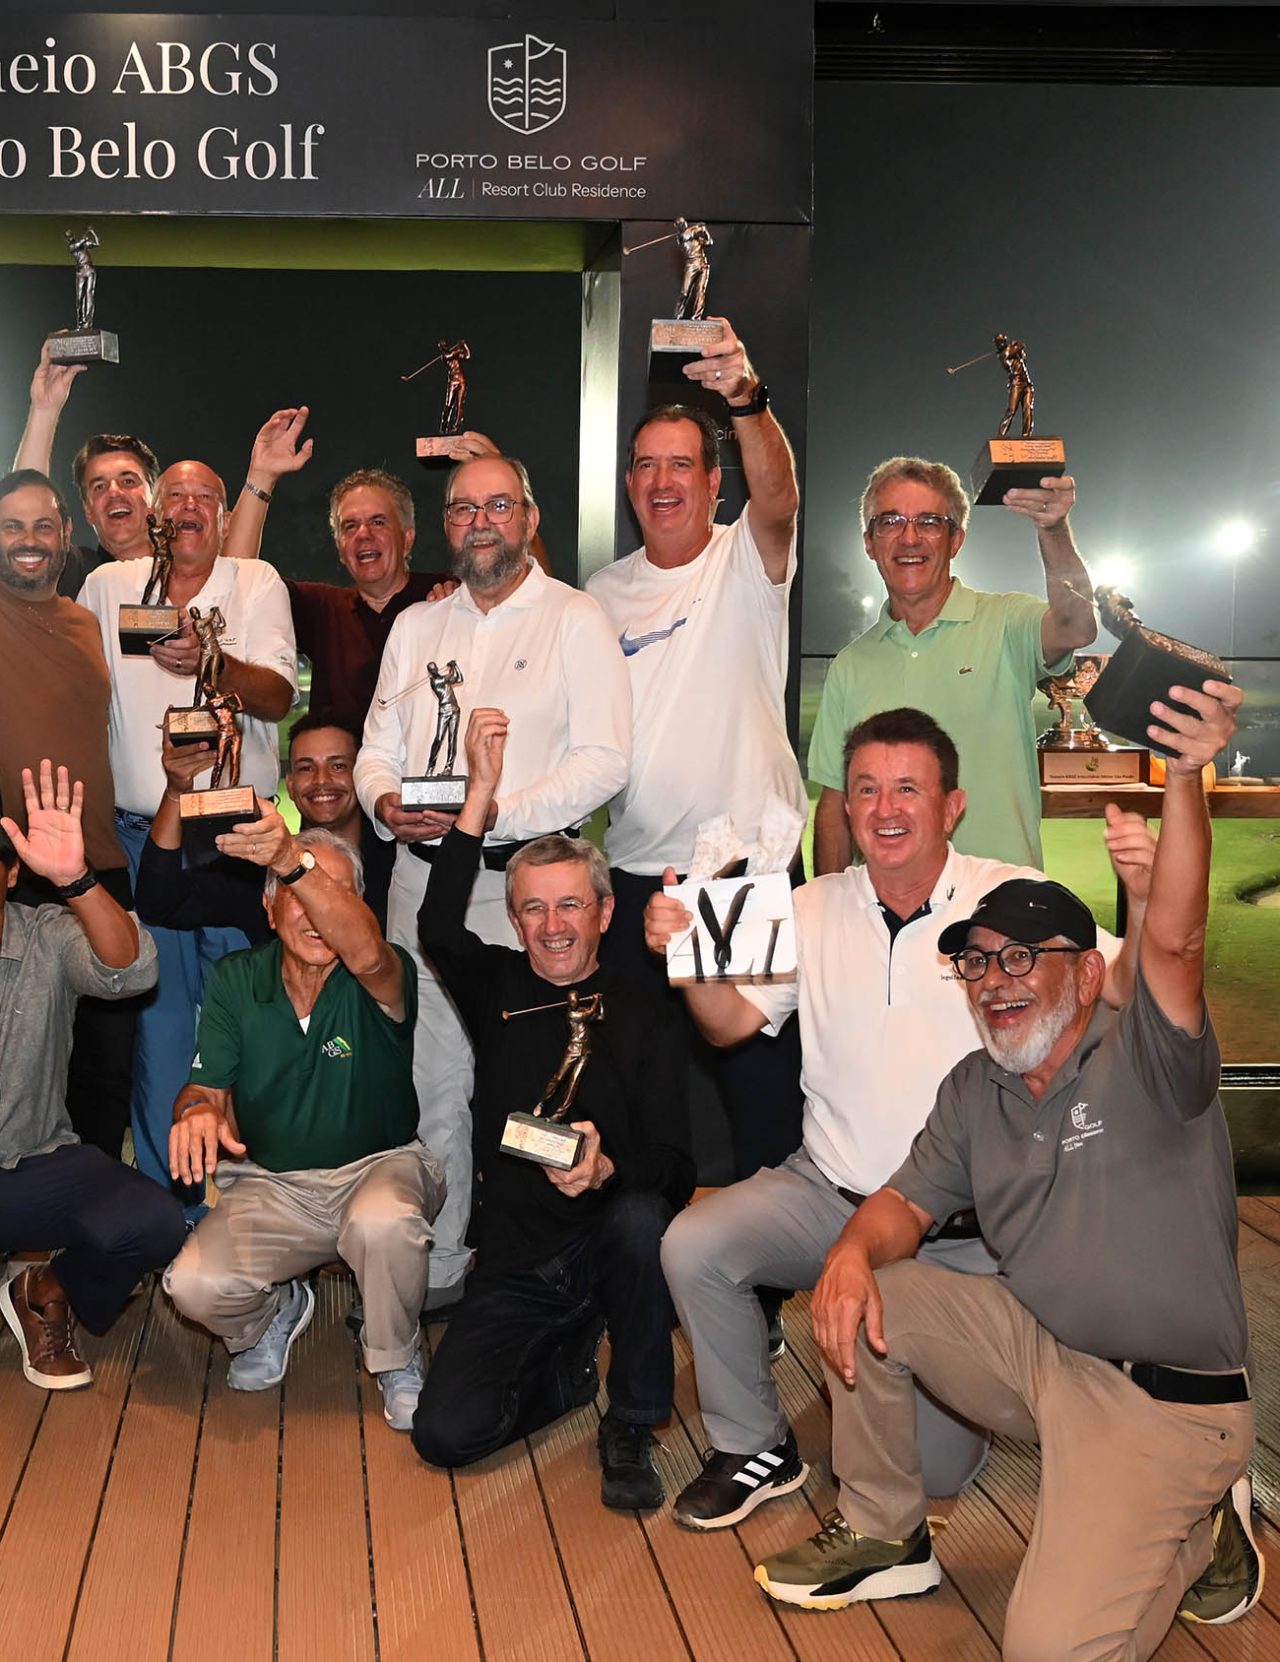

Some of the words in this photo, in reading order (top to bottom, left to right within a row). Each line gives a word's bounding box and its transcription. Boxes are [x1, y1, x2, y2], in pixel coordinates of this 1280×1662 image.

[111, 41, 280, 97] ABGS
[47, 122, 177, 181] Belo
[197, 122, 326, 182] Golf
[416, 153, 498, 170] PORTO
[507, 154, 571, 171] BELO
[580, 155, 648, 172] GOLF
[417, 177, 466, 200] ALL
[482, 181, 530, 197] Resort
[532, 181, 568, 198] Club
[571, 182, 647, 199] Residence
